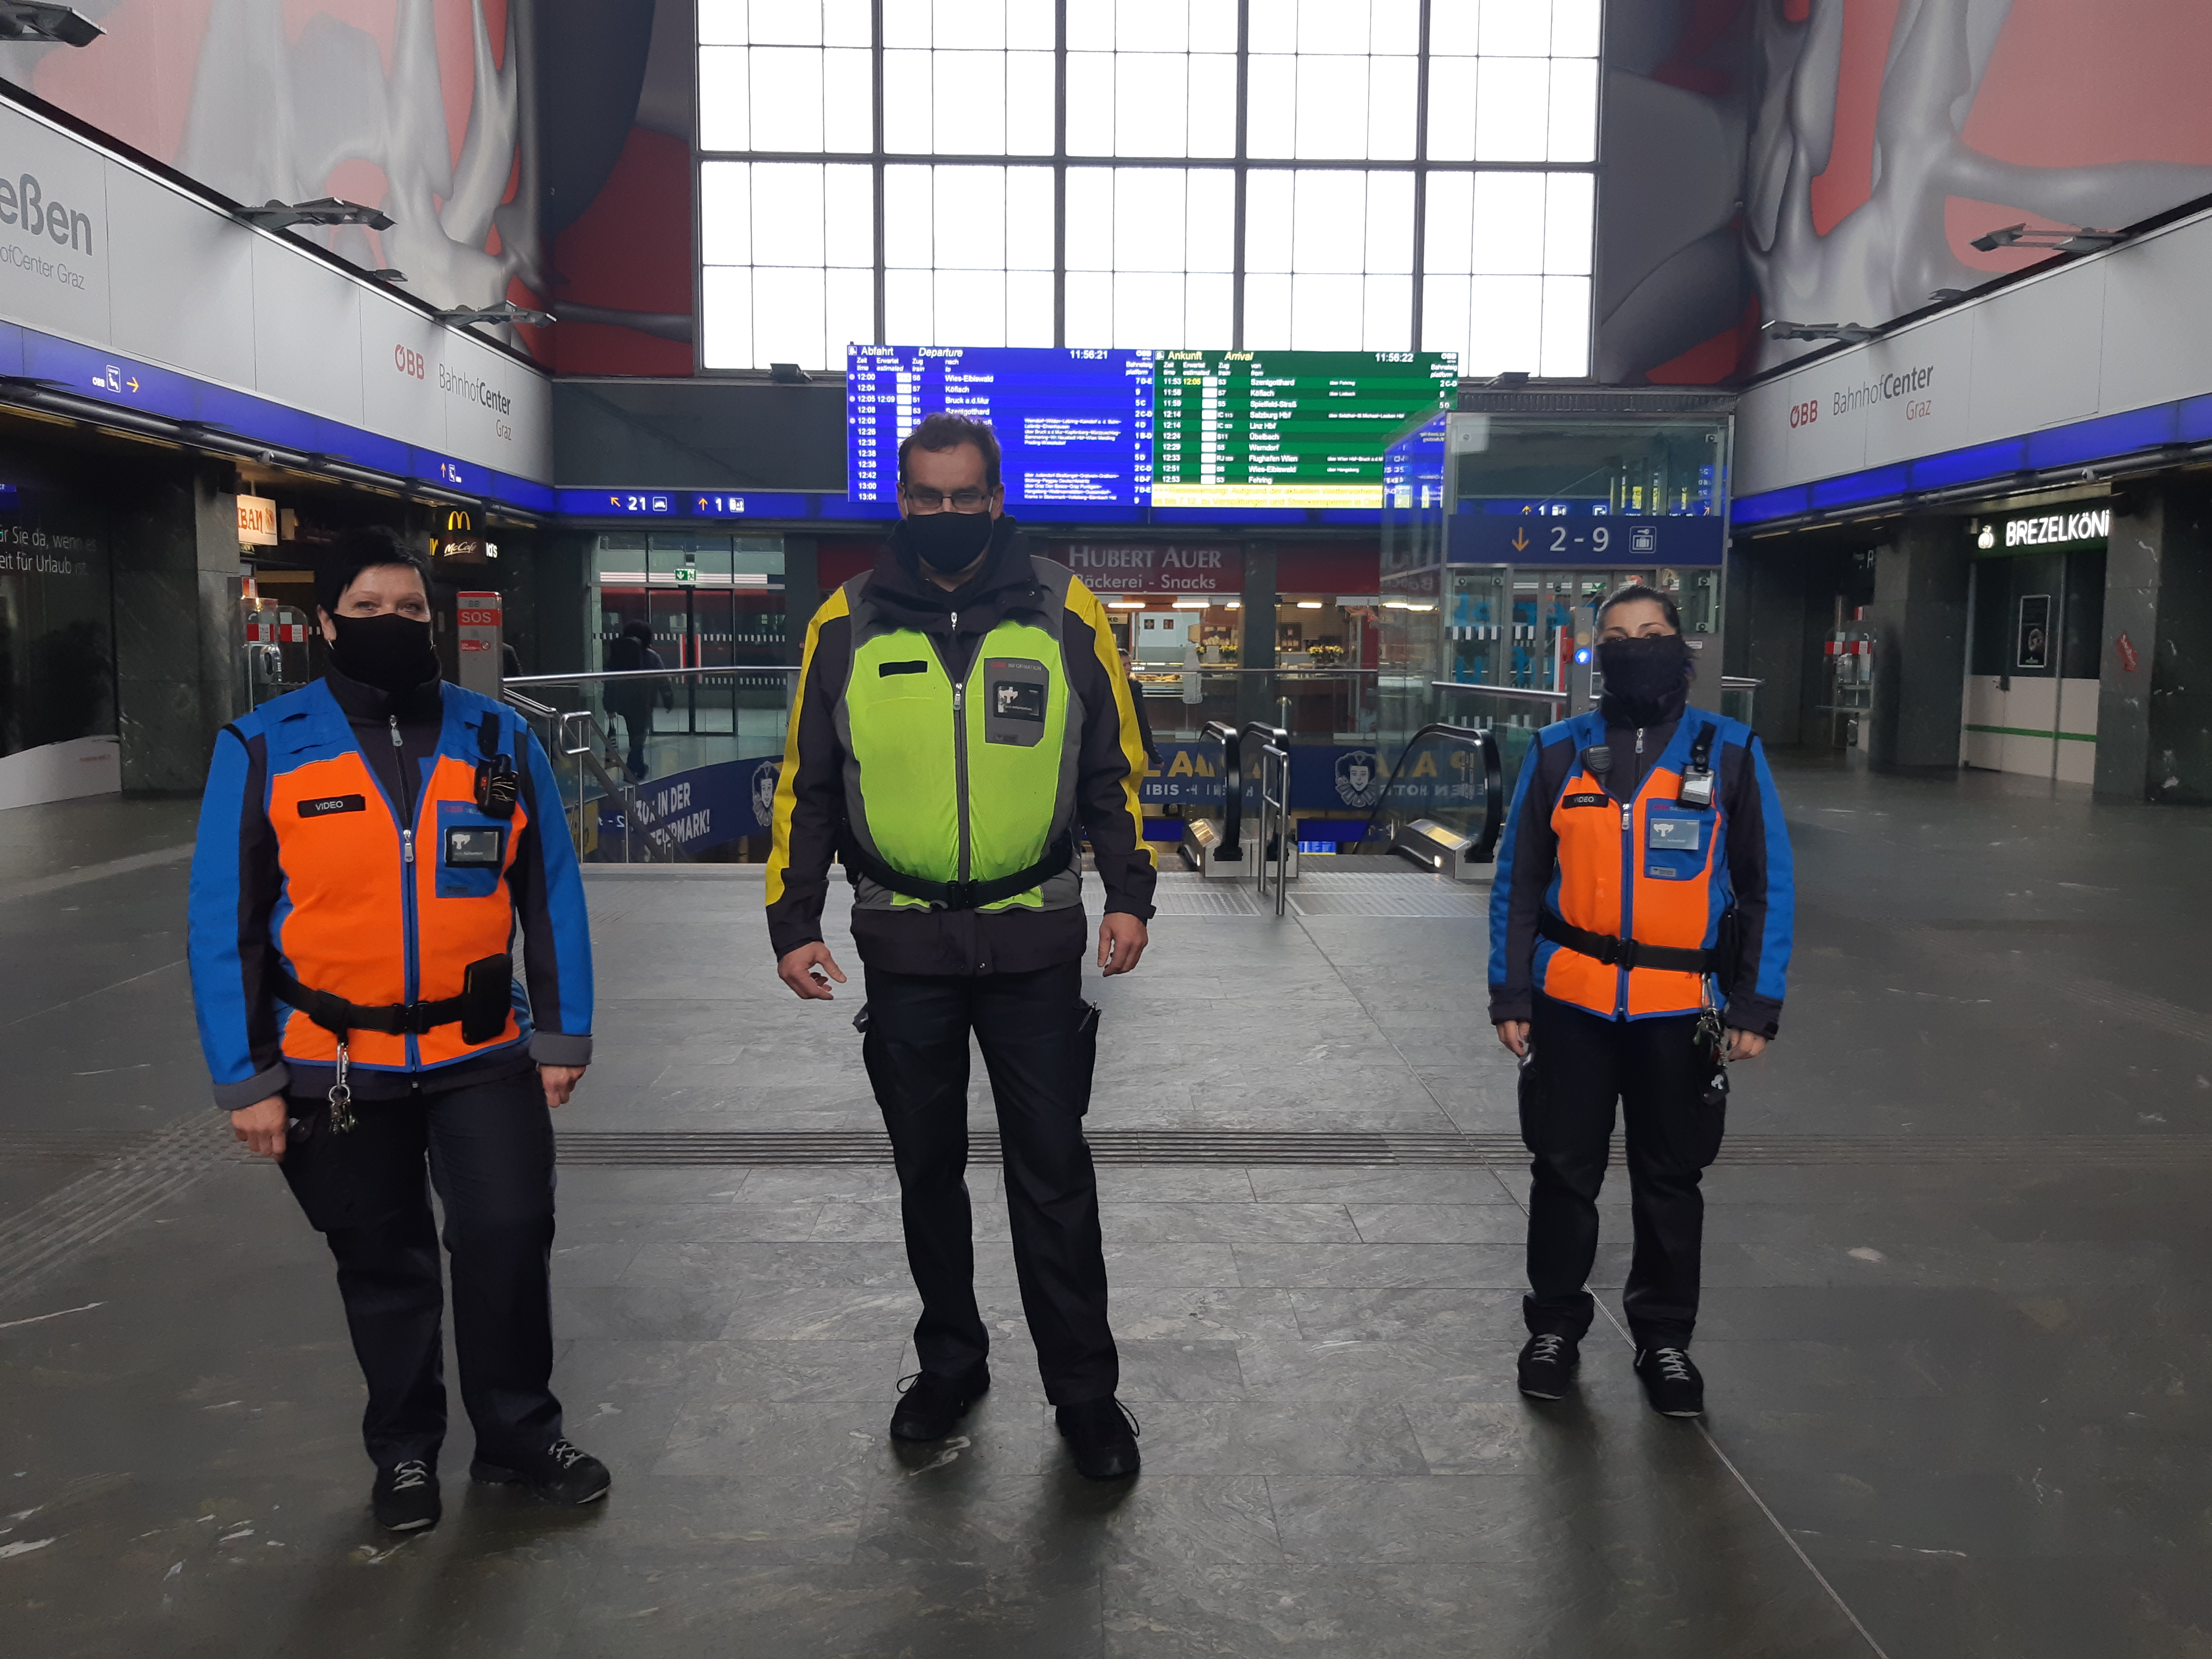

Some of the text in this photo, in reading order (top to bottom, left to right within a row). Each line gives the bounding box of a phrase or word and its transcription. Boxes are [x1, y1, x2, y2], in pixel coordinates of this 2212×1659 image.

[57, 263, 85, 290] Graz
[861, 347, 1108, 359] Abfahrt Departure 11:56:21
[1168, 351, 1202, 360] Ankunft
[1375, 353, 1413, 362] 11:56:22
[395, 344, 511, 416] ÖBB BahnhofCenter
[1790, 365, 1934, 428] ÖBB BahnhofCenter
[1250, 411, 1278, 420] Salzburg
[1906, 399, 1932, 420] Graz
[496, 419, 512, 441] Graz
[1249, 432, 1279, 440] Übelbach
[1249, 455, 1280, 463] Flughafen
[1248, 476, 1273, 485] Fehring
[628, 497, 646, 510] 21
[715, 498, 722, 510] 1
[1539, 505, 1543, 516] 1
[12, 526, 28, 545] Sie
[32, 529, 48, 549] da,
[1550, 527, 1566, 552] 2
[1593, 527, 1609, 552] 9
[444, 541, 477, 557] McCafé
[16, 552, 33, 571] für
[36, 554, 72, 574] Urlaub
[1069, 545, 1221, 568] HUBERT AUER
[1161, 575, 1216, 589] Snacks
[461, 612, 492, 623] SOS
[1146, 784, 1179, 795] IBIS
[315, 800, 343, 810] VIDEO
[659, 790, 668, 817] IN
[671, 782, 690, 813] DER
